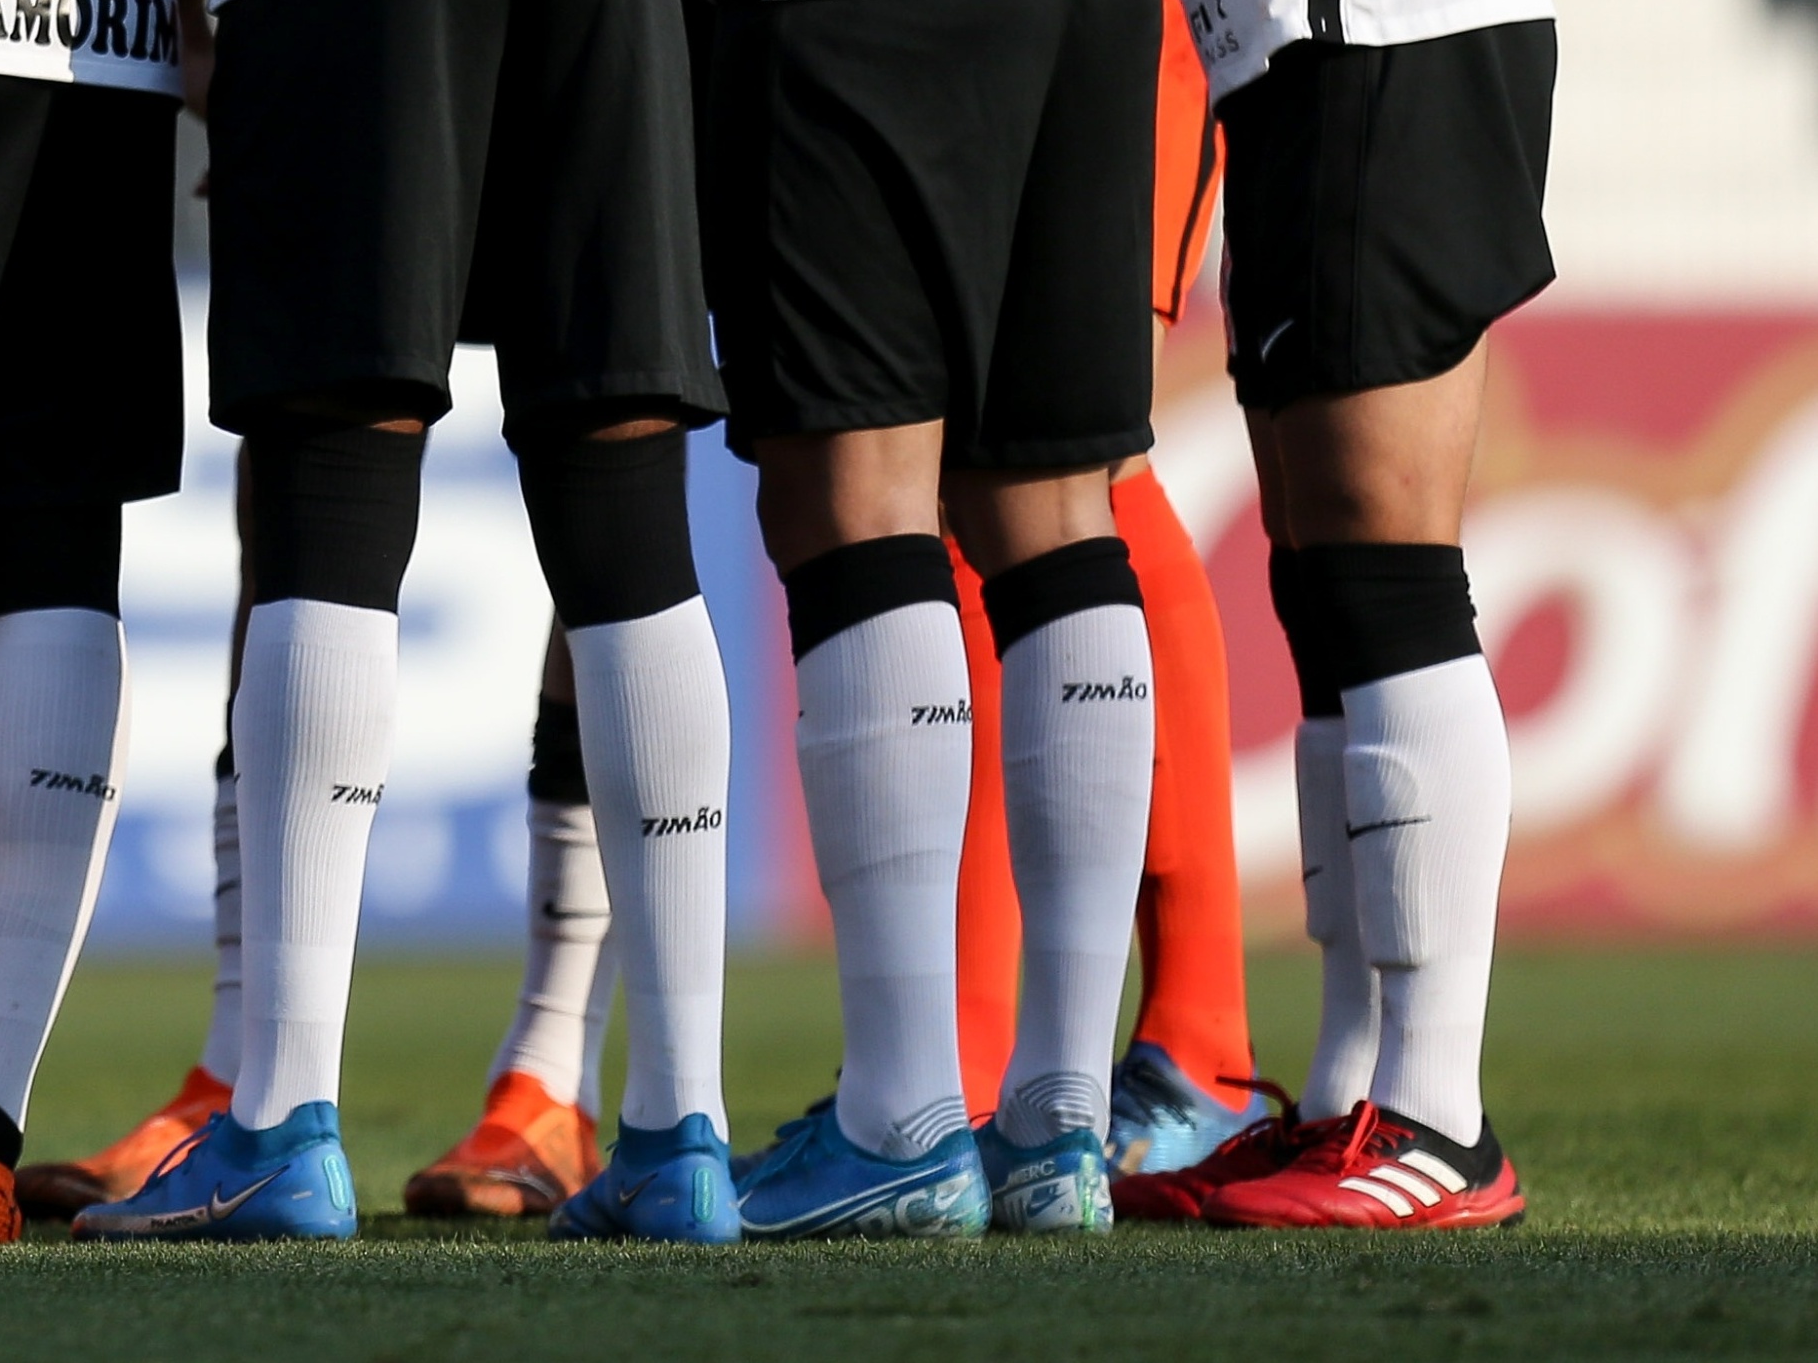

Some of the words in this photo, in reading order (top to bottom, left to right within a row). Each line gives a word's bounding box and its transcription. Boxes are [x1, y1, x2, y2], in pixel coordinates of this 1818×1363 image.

[1061, 674, 1148, 703] TIMÃO
[28, 767, 116, 802] TIMÃO
[640, 807, 723, 838] TIMÃO
